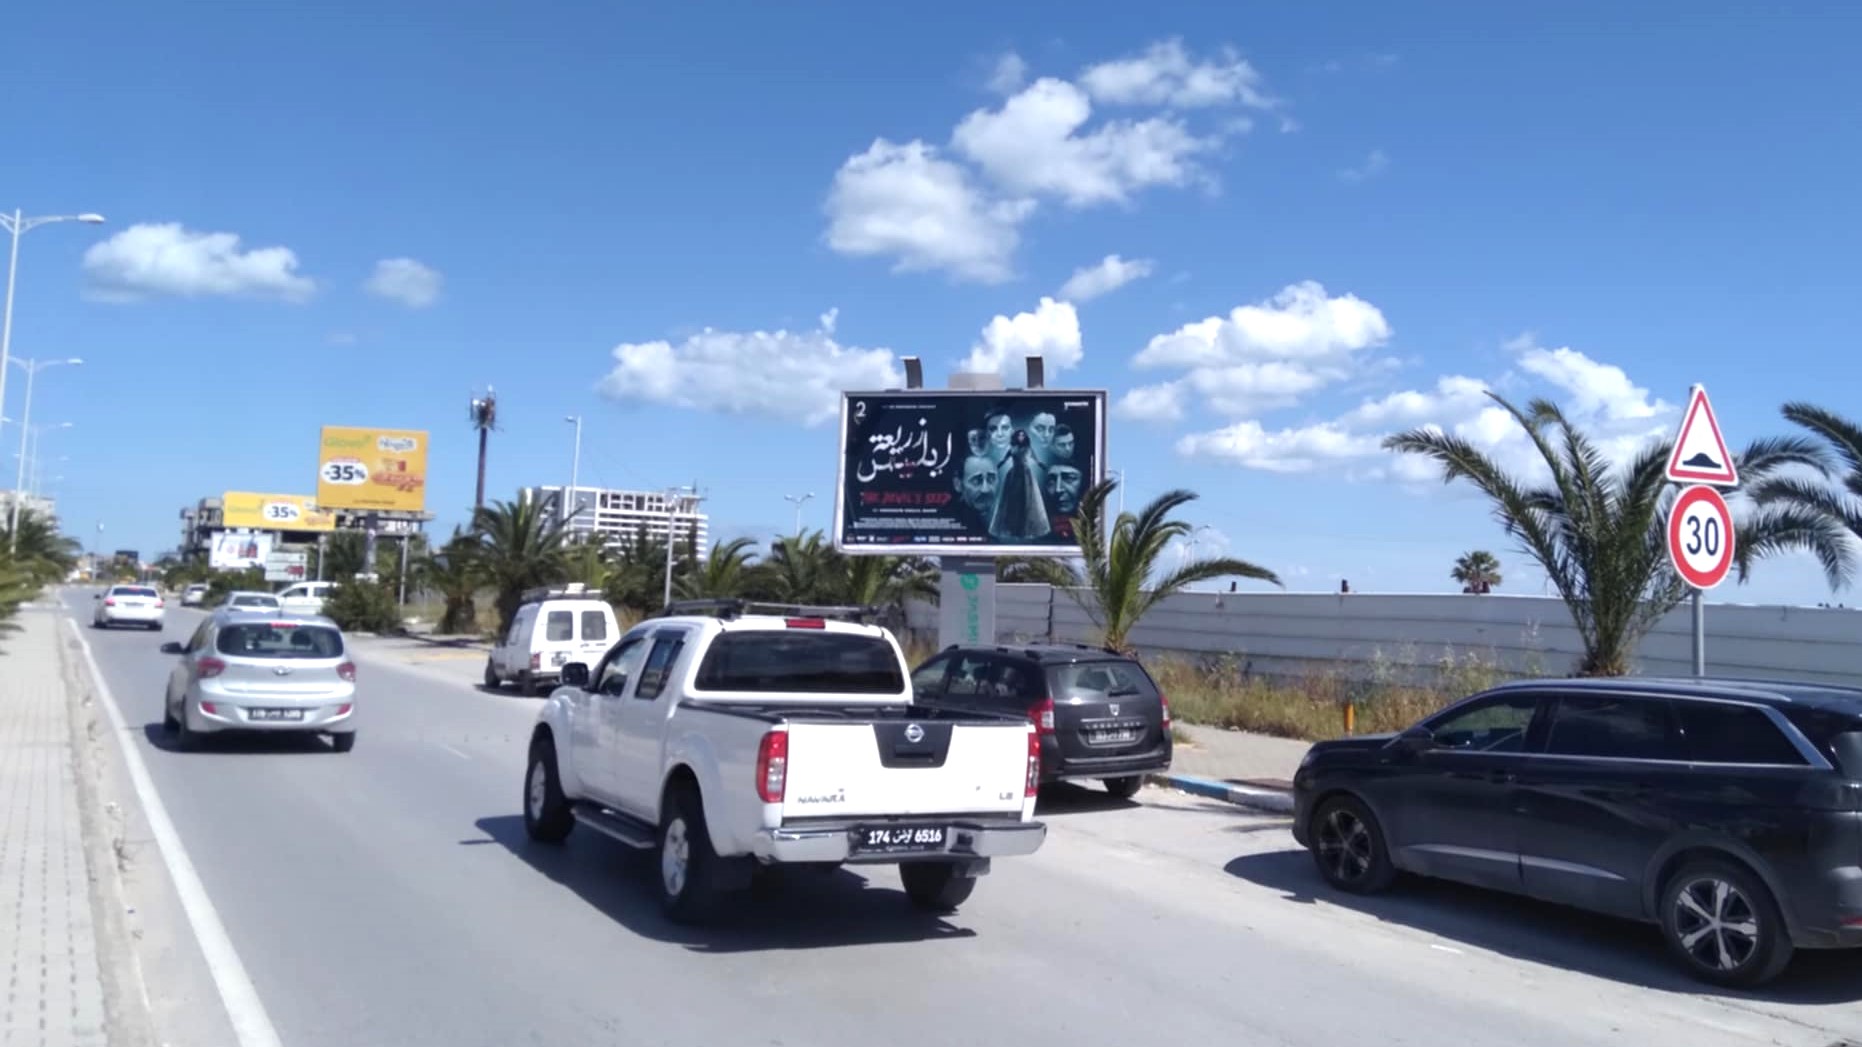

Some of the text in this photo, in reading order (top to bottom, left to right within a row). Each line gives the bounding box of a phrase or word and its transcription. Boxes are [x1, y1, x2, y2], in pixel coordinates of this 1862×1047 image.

[324, 464, 366, 482] -35%
[1686, 514, 1719, 557] 30
[867, 830, 891, 845] 174
[914, 828, 943, 843] 6516
